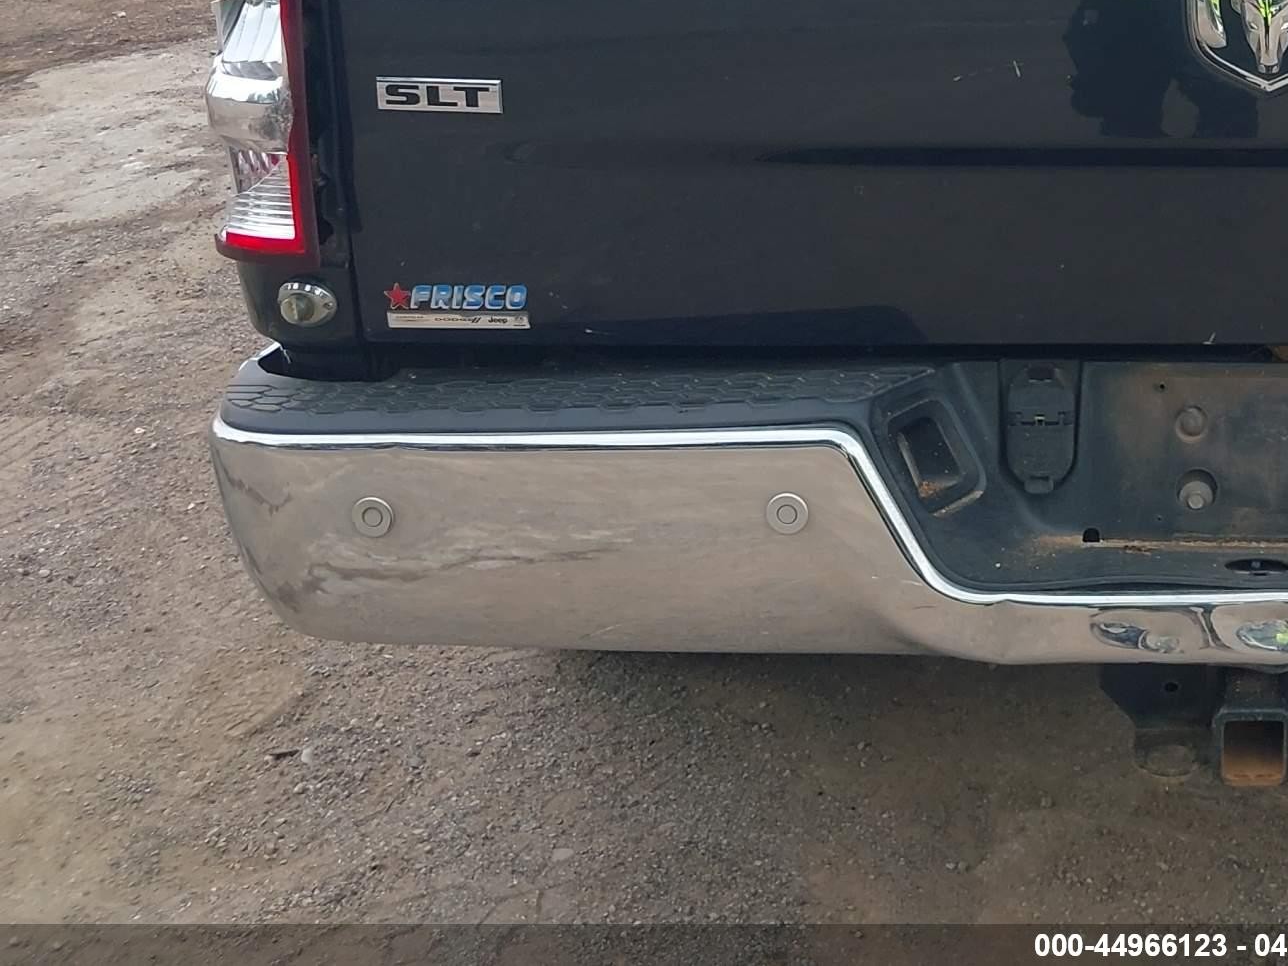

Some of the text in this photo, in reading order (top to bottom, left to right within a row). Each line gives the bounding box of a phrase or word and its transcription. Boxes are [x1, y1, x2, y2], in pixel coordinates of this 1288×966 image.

[385, 84, 490, 108] SLT
[410, 283, 528, 310] FRISCO
[488, 316, 508, 325] Jeep
